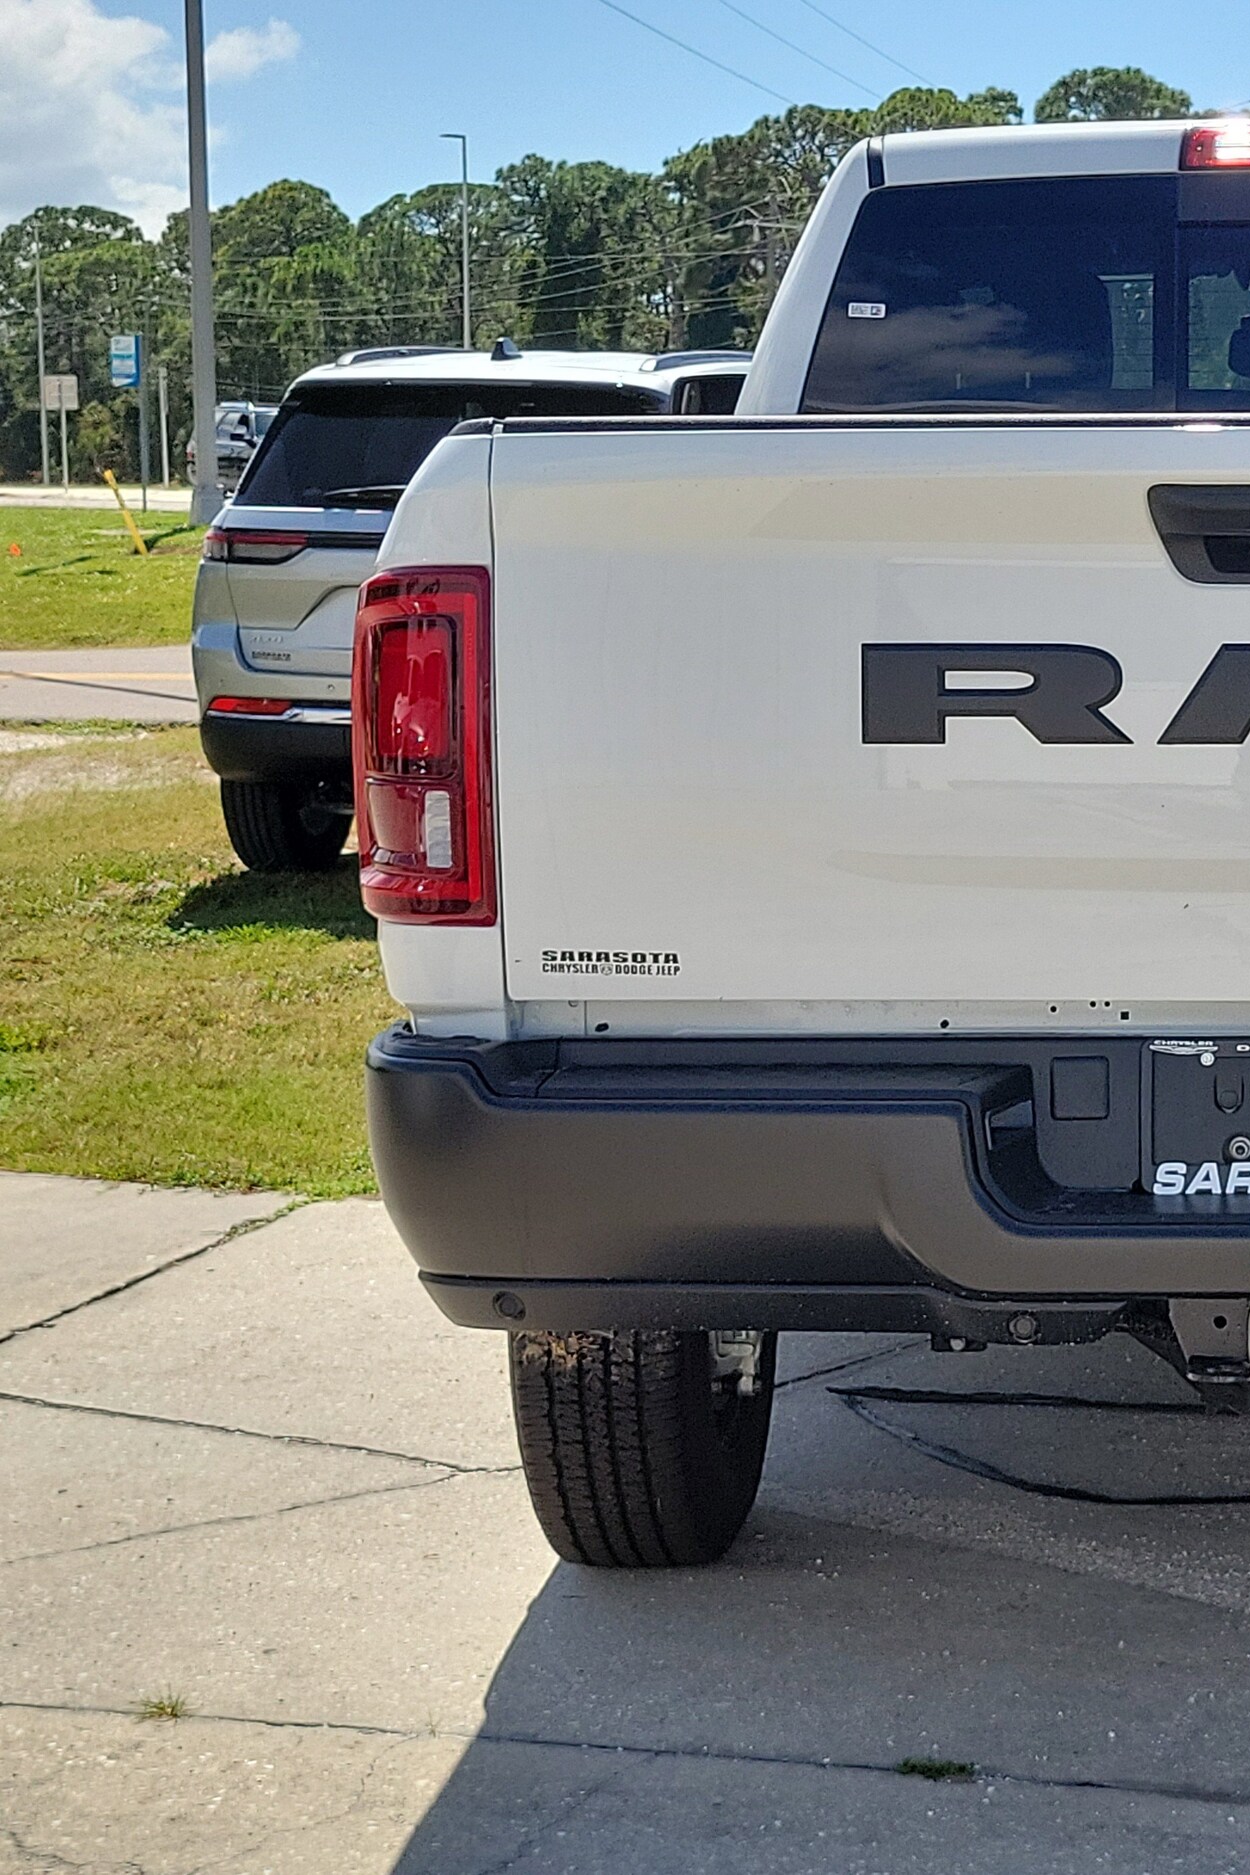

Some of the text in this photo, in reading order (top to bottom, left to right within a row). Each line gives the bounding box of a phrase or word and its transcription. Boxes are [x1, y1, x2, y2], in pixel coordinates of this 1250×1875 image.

[541, 949, 680, 964] SARASOTA
[541, 963, 681, 976] CHRYSLER DODGE JEEP
[1153, 1039, 1214, 1047] CHRYSLER
